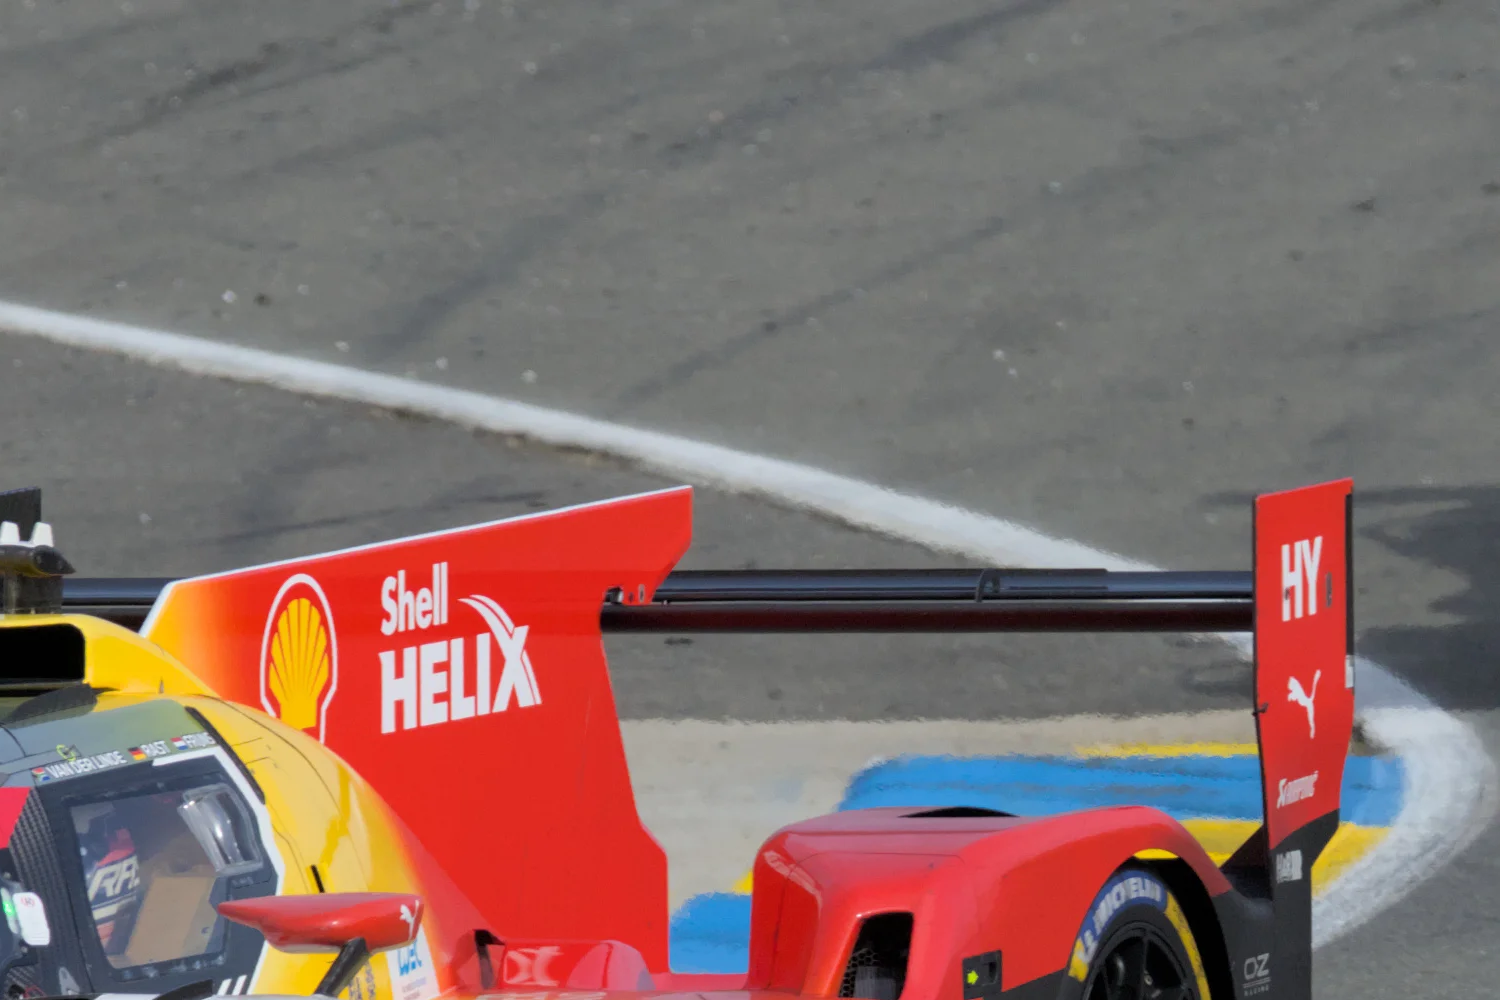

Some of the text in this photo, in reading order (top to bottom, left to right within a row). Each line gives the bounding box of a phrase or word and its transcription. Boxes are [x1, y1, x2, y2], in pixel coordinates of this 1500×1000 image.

[380, 561, 448, 636] Shell
[1281, 535, 1323, 622] HY
[378, 593, 542, 735] HELIX
[45, 750, 128, 779] VAN DER LINDE
[140, 740, 172, 757] RAST
[1092, 876, 1162, 936] MICHELIN
[1243, 952, 1270, 981] OZ
